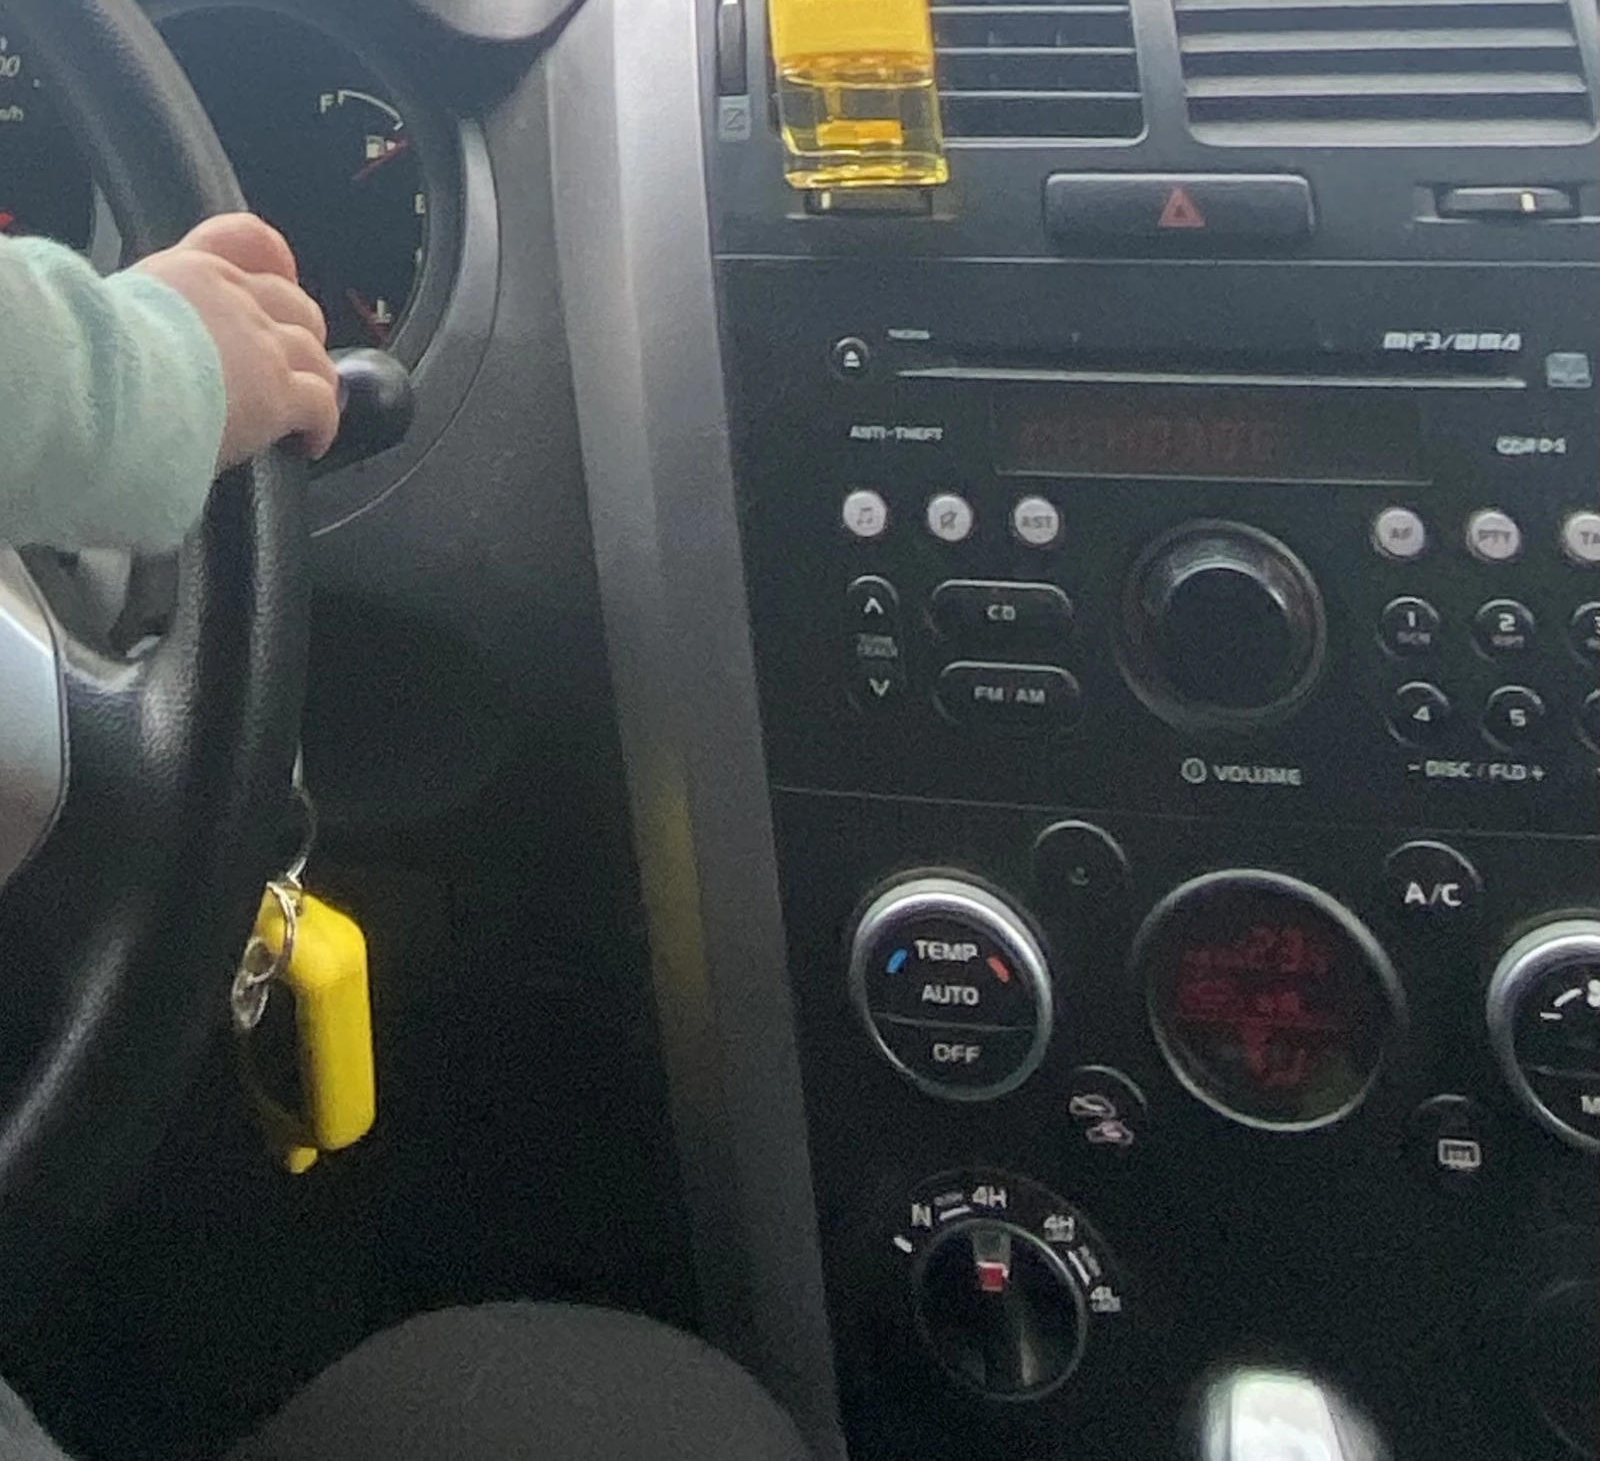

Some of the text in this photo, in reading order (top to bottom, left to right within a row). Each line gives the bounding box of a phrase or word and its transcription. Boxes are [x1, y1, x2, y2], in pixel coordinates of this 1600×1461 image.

[850, 425, 943, 442] ANTI-THEFT
[987, 605, 1016, 621] CD
[1406, 611, 1416, 628] 1
[1499, 613, 1515, 632] 2
[1412, 706, 1431, 722] 4
[1509, 709, 1526, 727] 5
[1212, 765, 1301, 786] VOLUME
[1404, 882, 1462, 907] A/C
[914, 939, 979, 963] TEMP
[922, 984, 979, 1006] AUTO
[933, 1043, 980, 1063] OFF
[972, 1186, 1007, 1209] 4H
[911, 1203, 932, 1228] N
